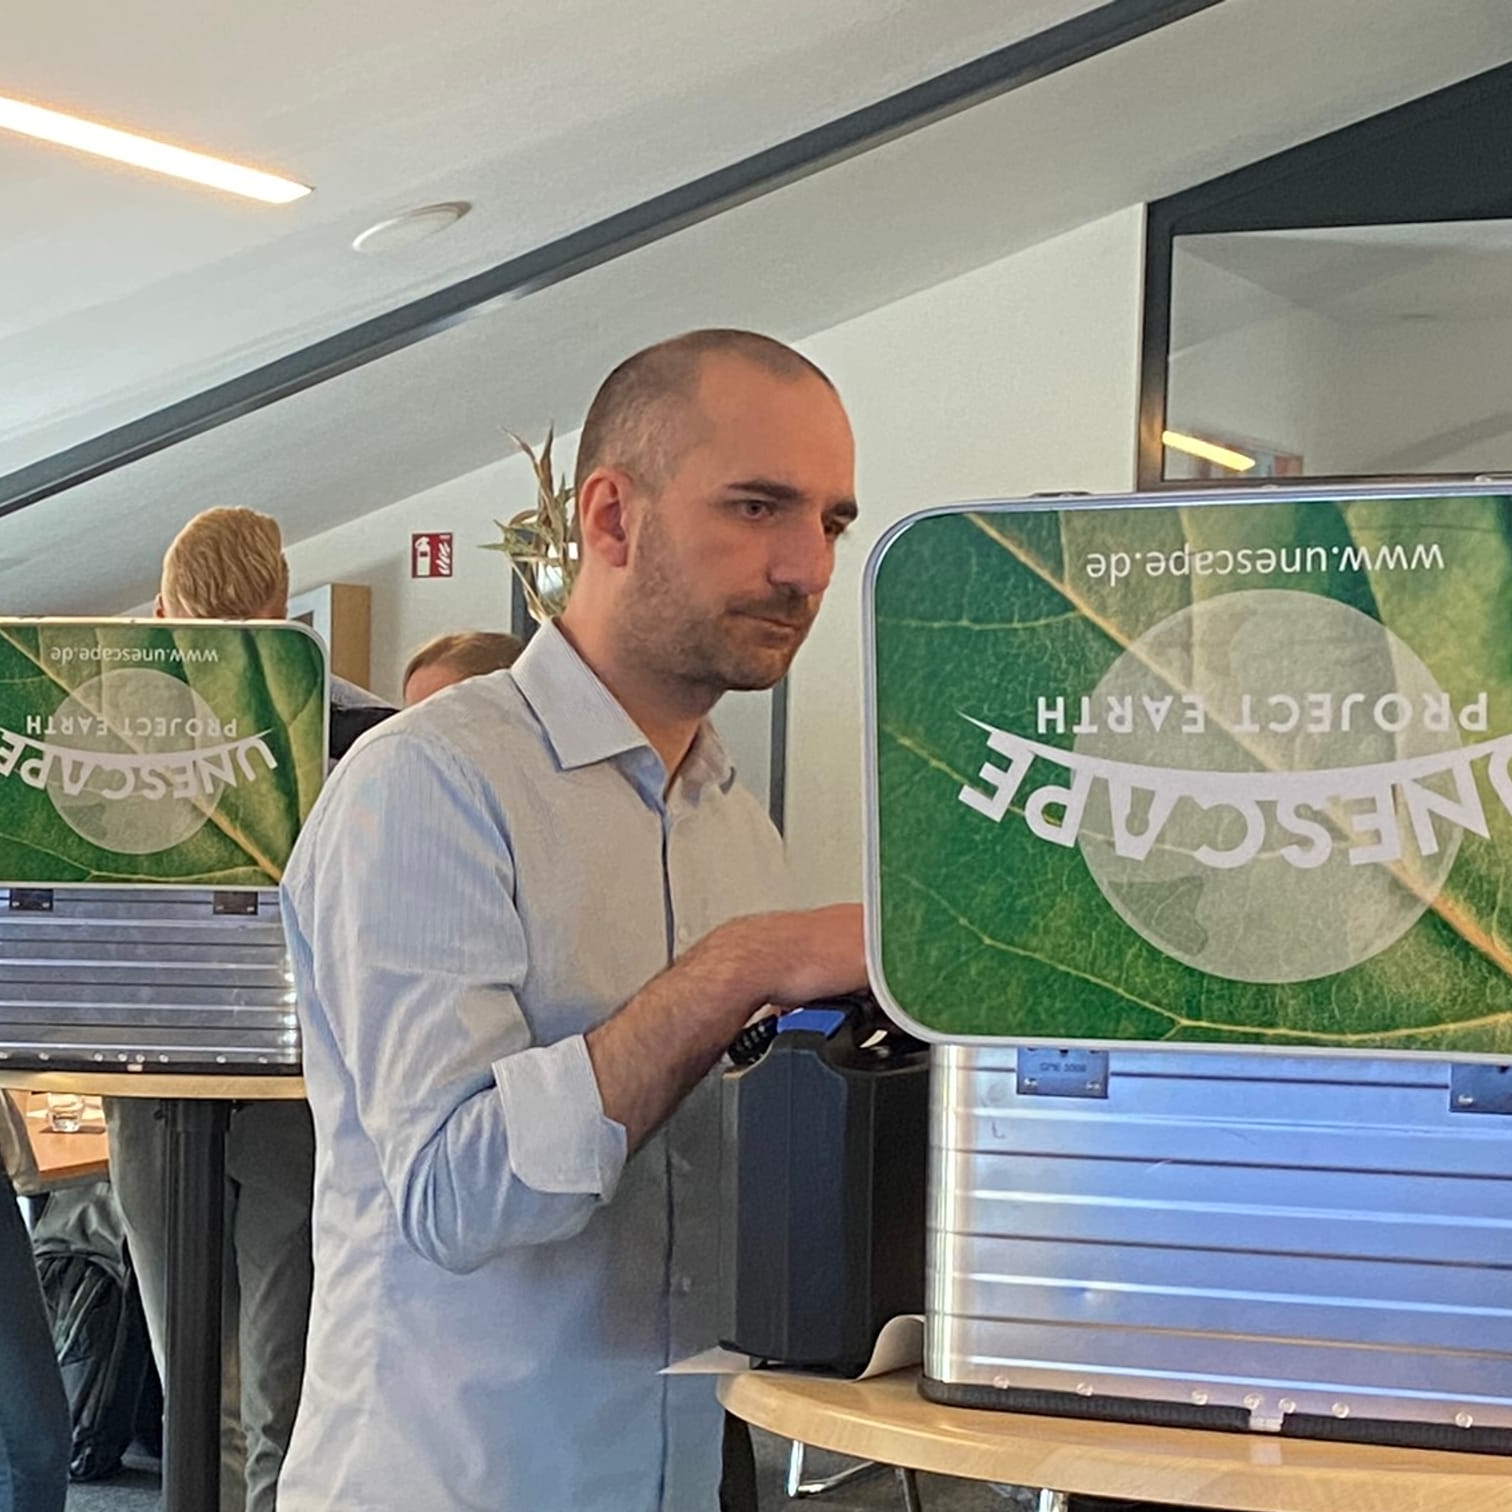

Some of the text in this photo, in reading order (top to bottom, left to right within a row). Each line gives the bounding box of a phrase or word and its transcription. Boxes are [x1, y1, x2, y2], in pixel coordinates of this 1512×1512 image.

[1085, 542, 1445, 587] www.unescape.de
[50, 646, 220, 665] www.unescape.de
[26, 714, 238, 738] PROJECT EARTH
[1036, 691, 1488, 736] PROJECT EARTH
[957, 728, 1512, 869] NESCAPE
